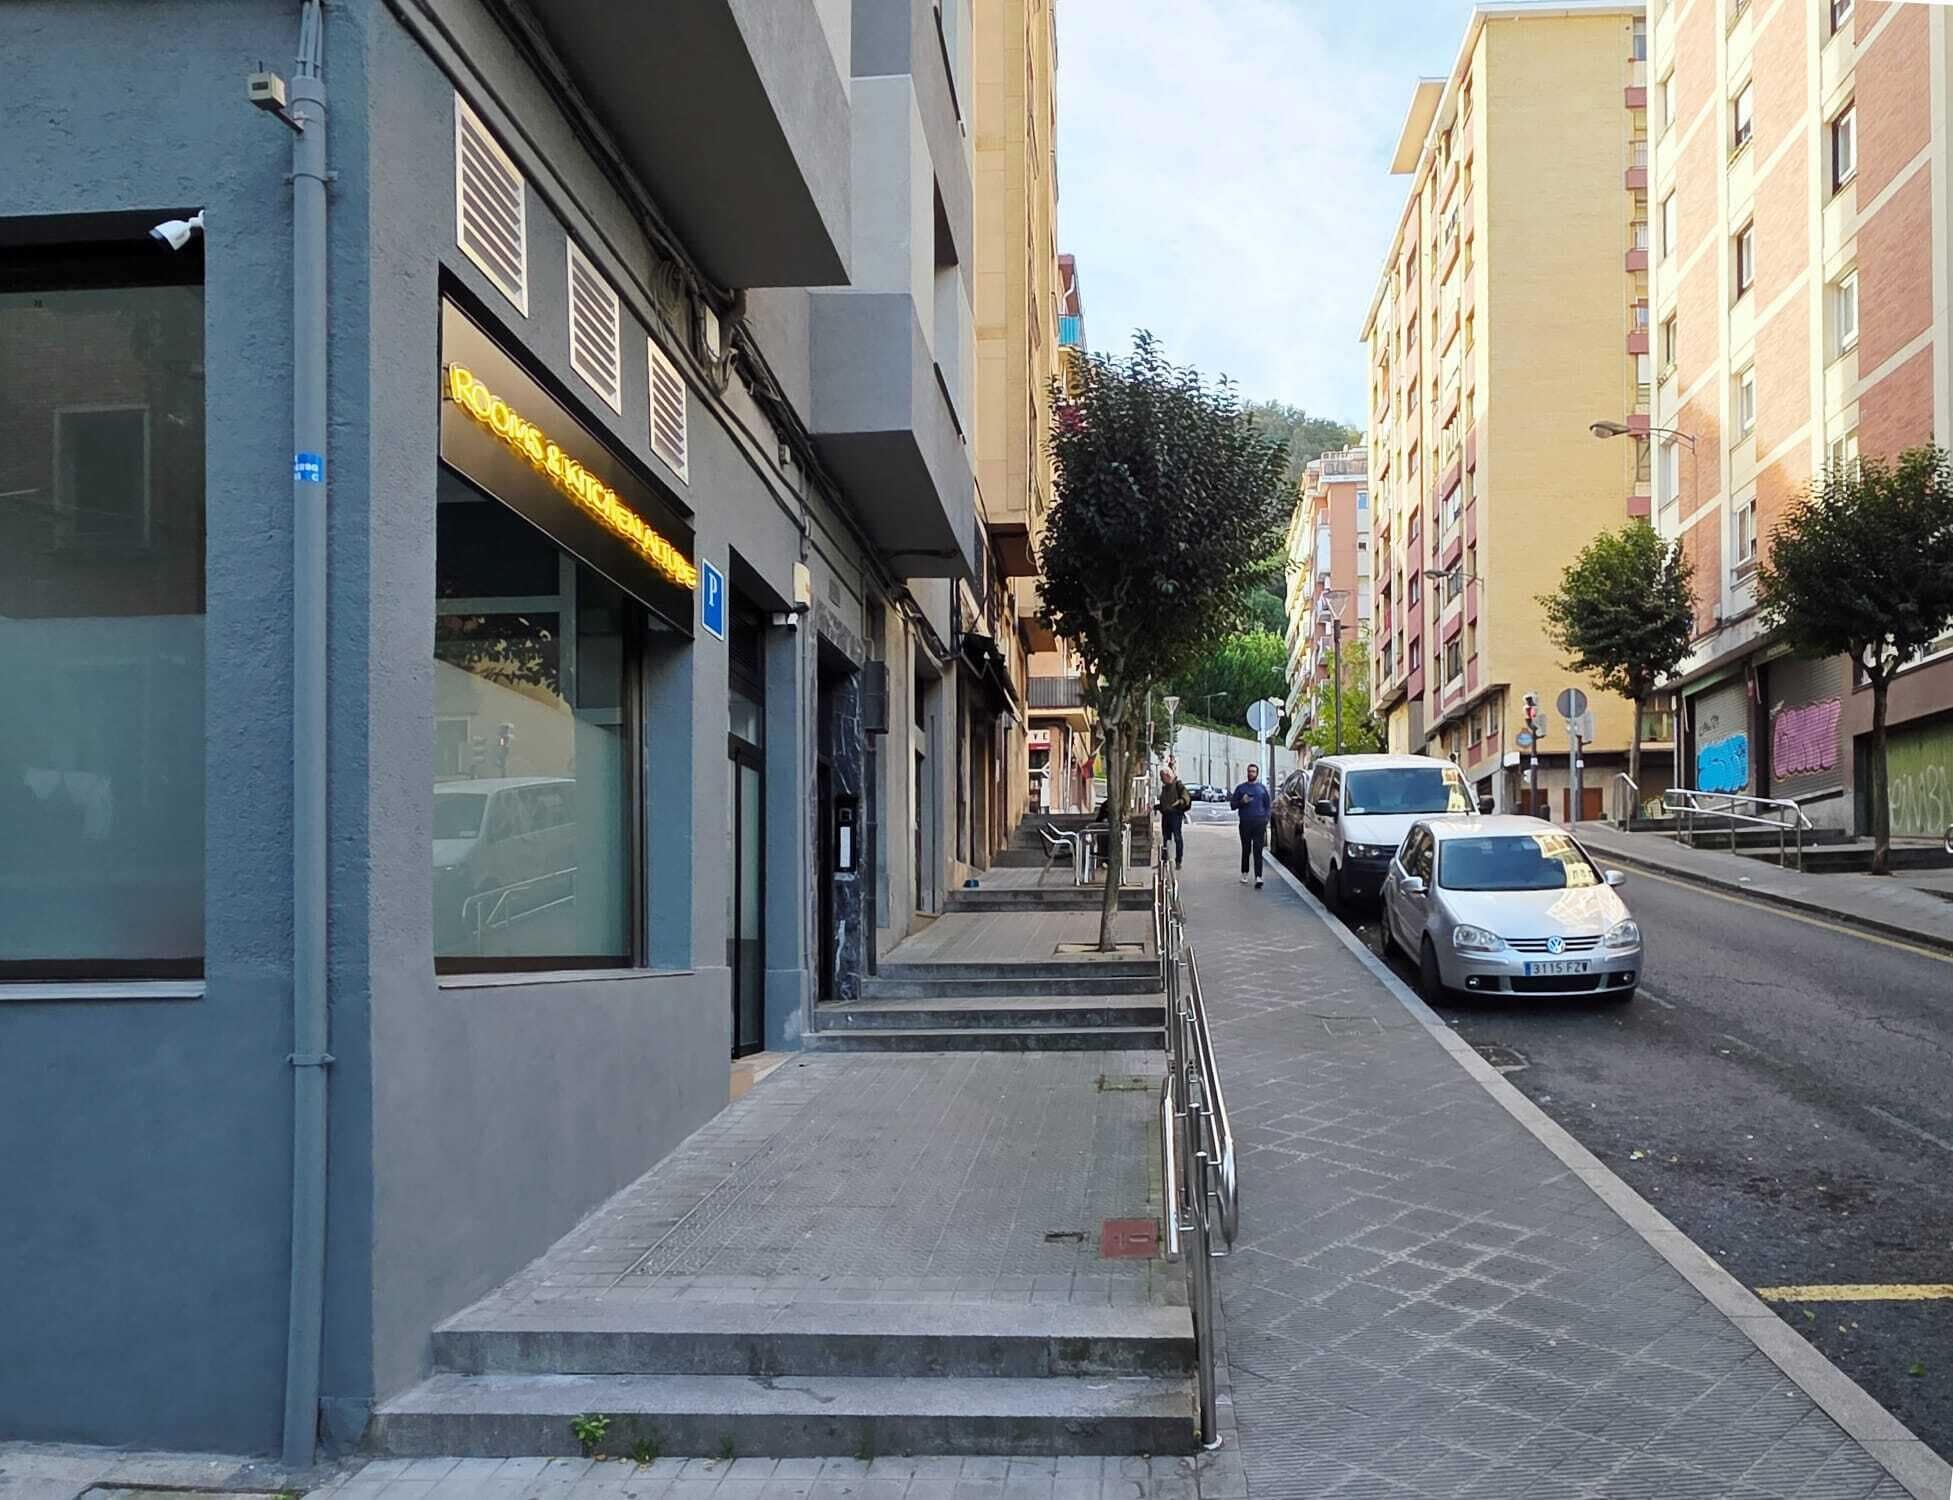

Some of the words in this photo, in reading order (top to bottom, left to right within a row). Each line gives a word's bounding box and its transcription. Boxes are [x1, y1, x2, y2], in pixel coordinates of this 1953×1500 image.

[449, 362, 545, 463] ROOMS
[545, 441, 562, 479] &
[560, 454, 643, 544] KITCHEN
[708, 571, 718, 607] P
[1533, 962, 1563, 975] 3115
